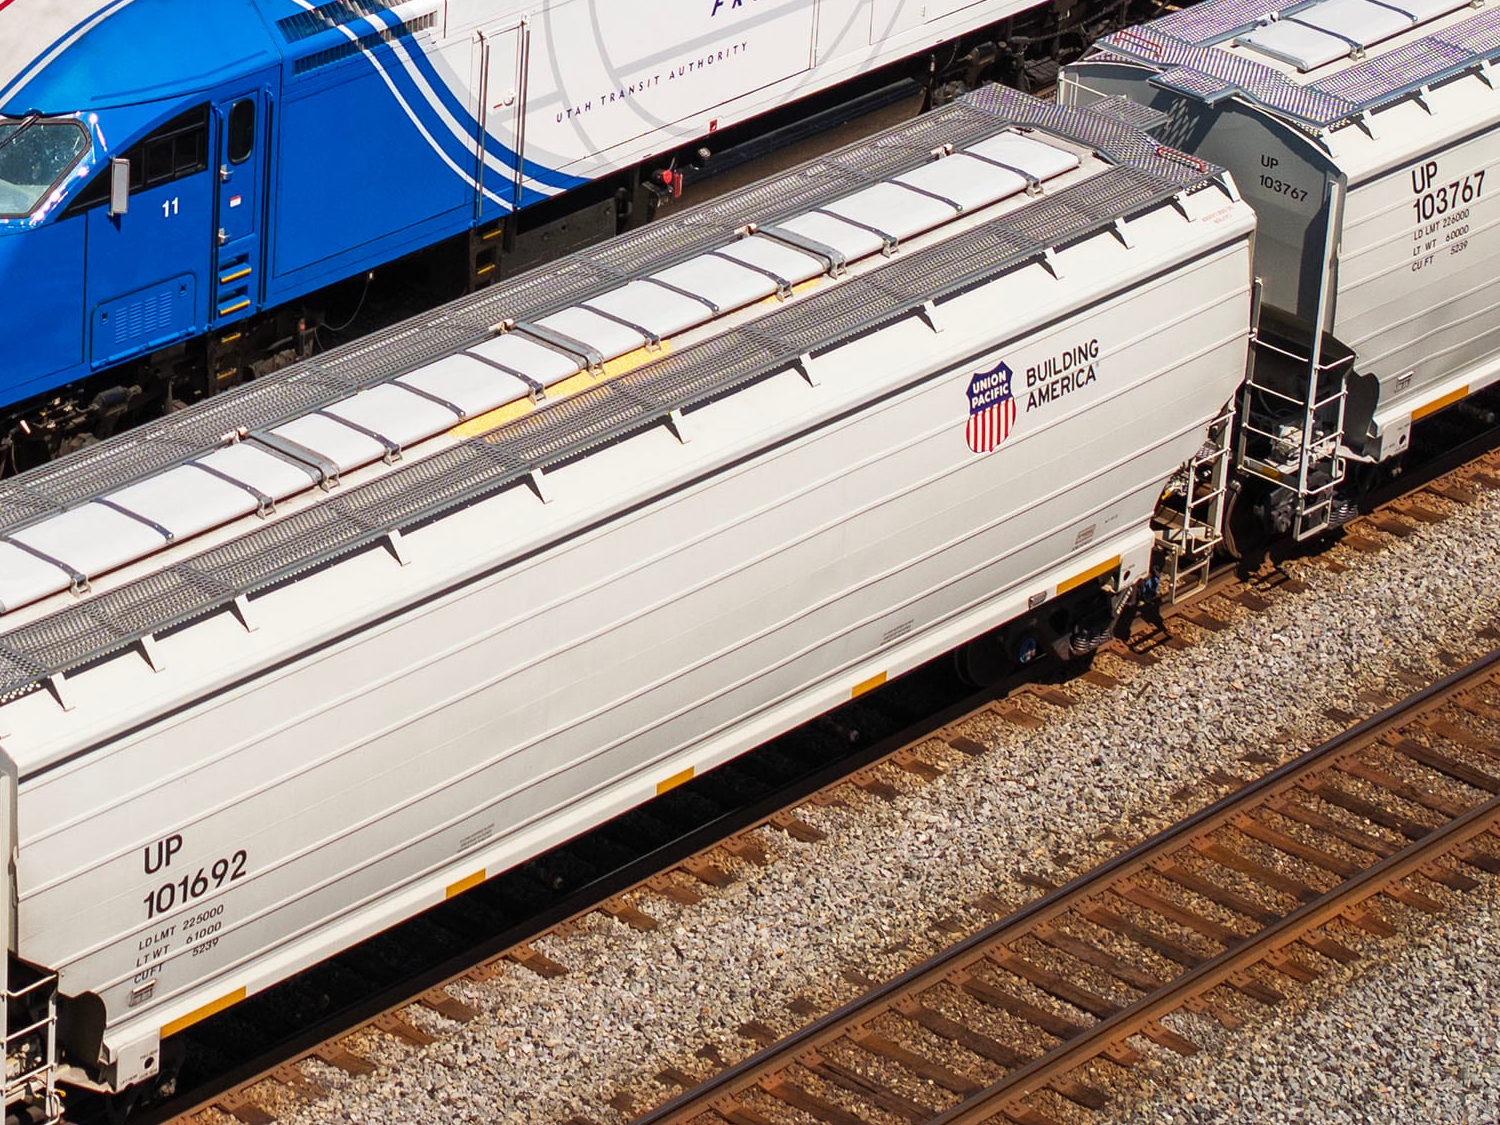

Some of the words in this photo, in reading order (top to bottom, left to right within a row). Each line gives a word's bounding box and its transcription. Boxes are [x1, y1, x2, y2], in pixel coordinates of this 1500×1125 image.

[556, 101, 591, 123] UTAH
[600, 75, 660, 106] TRANSIT
[669, 42, 748, 80] AUTHORITY
[1260, 154, 1279, 170] UP
[1412, 161, 1438, 194] UP
[1259, 174, 1308, 203] 103767
[1413, 170, 1485, 223] 103767
[162, 197, 179, 218] 11
[1413, 245, 1421, 256] LT
[1425, 239, 1437, 251] WT
[1445, 224, 1469, 242] 60000
[1414, 229, 1423, 240] LD
[1425, 221, 1440, 235] LMT
[1442, 208, 1469, 228] 226000
[1450, 240, 1468, 255] 5239
[1026, 339, 1099, 388] BUILDING
[971, 383, 1009, 409] PACIFIC
[972, 370, 1006, 394] UNION
[1026, 364, 1097, 412] AMERICA
[144, 834, 183, 875] UP
[143, 849, 247, 919] 101692
[182, 904, 224, 931] 225000
[136, 954, 149, 968] LT
[153, 944, 170, 959] WT
[185, 921, 222, 945] 61000
[191, 938, 219, 957] 5239
